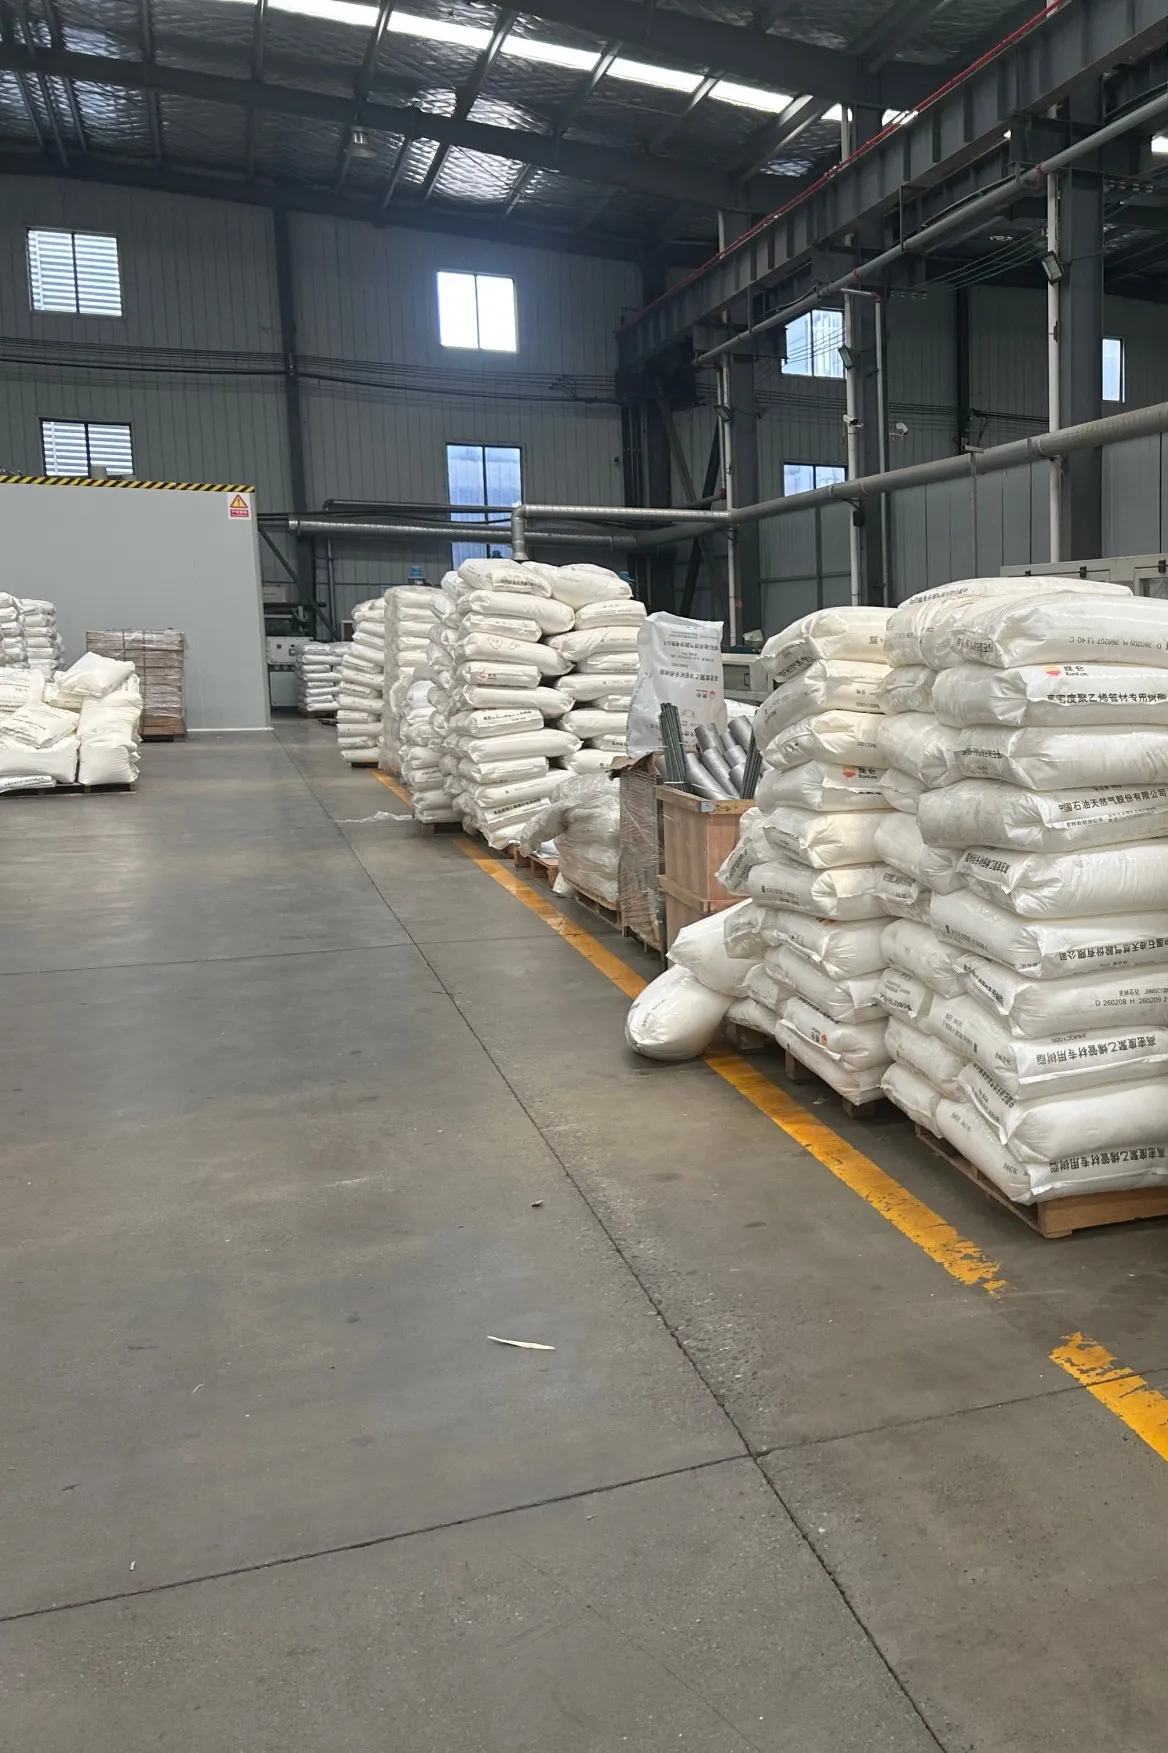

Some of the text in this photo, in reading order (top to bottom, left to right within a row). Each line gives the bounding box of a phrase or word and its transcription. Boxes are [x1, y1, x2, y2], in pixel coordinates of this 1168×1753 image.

[1058, 788, 1168, 813] 中国石油天然气股份有限公司
[1094, 999, 1101, 1007] D
[1129, 997, 1136, 1005] H
[1035, 1034, 1157, 1066] 高密度聚乙烯管材专用树脂
[1048, 1147, 1168, 1174] 高密度聚乙烯管材专用树脂
